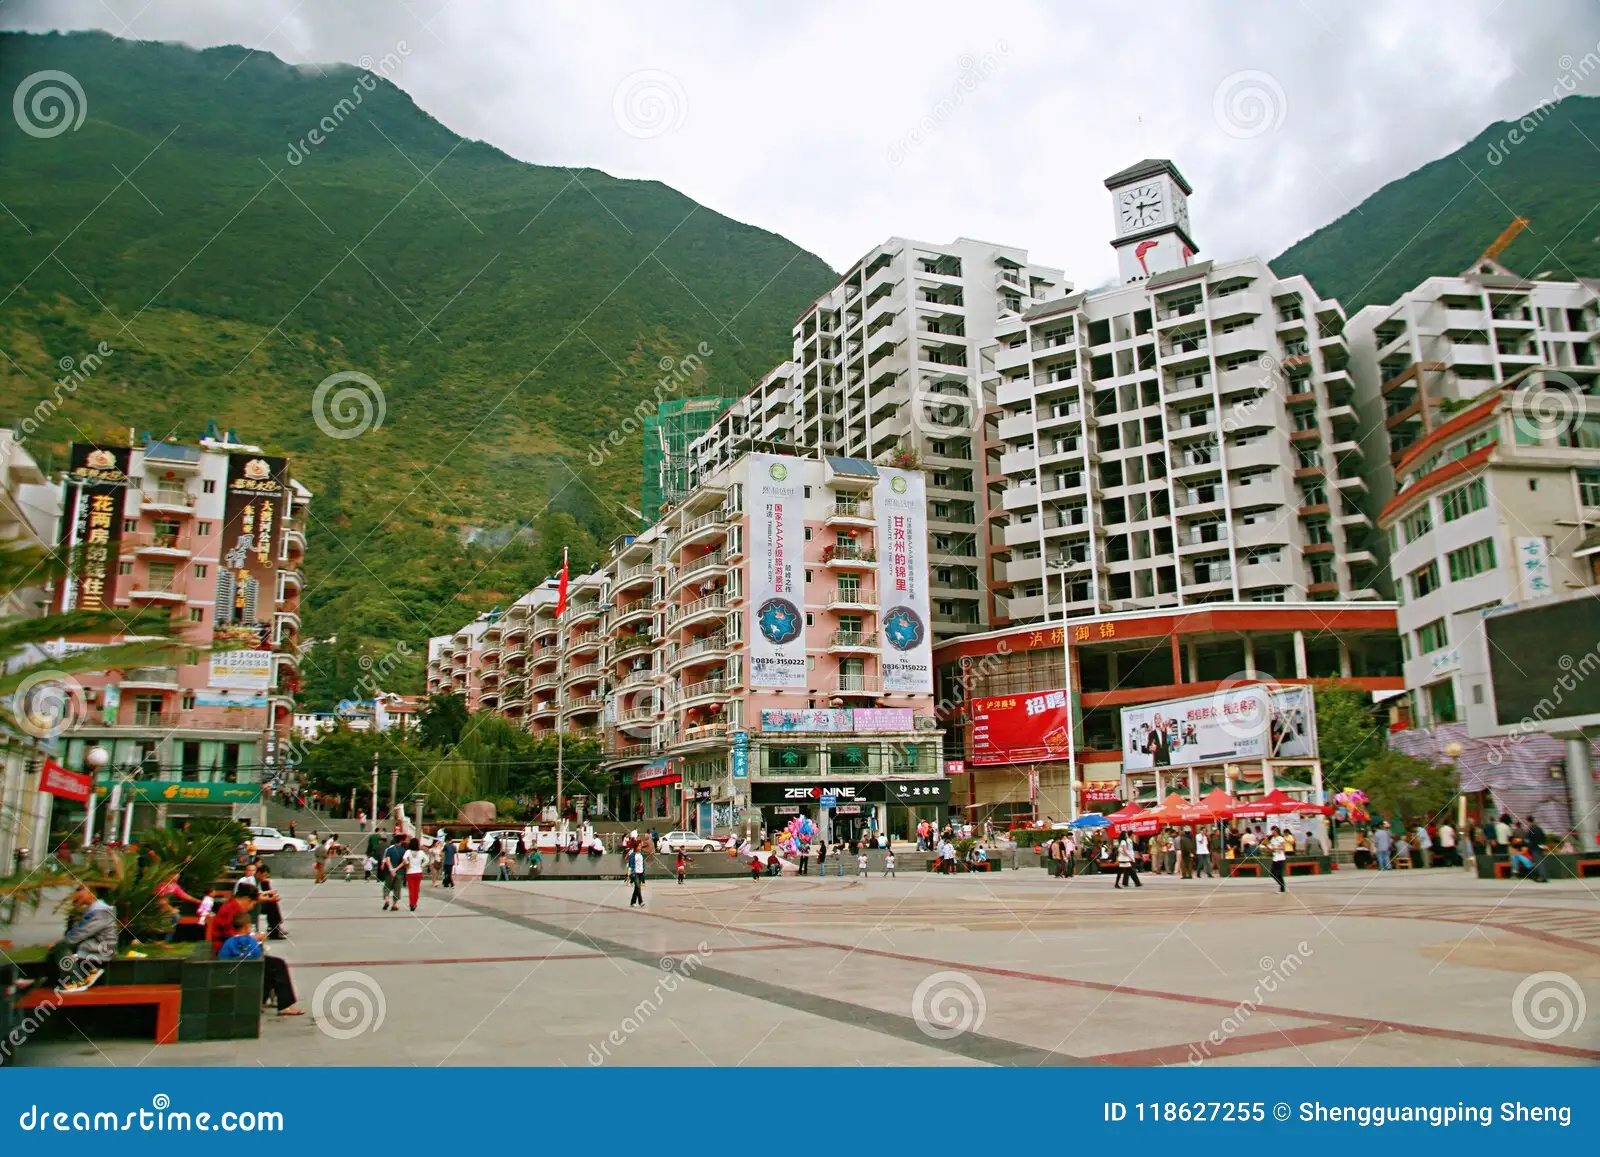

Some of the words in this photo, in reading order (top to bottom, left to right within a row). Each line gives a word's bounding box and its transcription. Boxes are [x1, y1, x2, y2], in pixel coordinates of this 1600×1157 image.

[893, 515, 907, 591] 甘孜州的锦里
[1029, 623, 1116, 647] 泸桥御锦
[755, 658, 805, 666] 0836-3150222
[1025, 691, 1066, 716] 招聘
